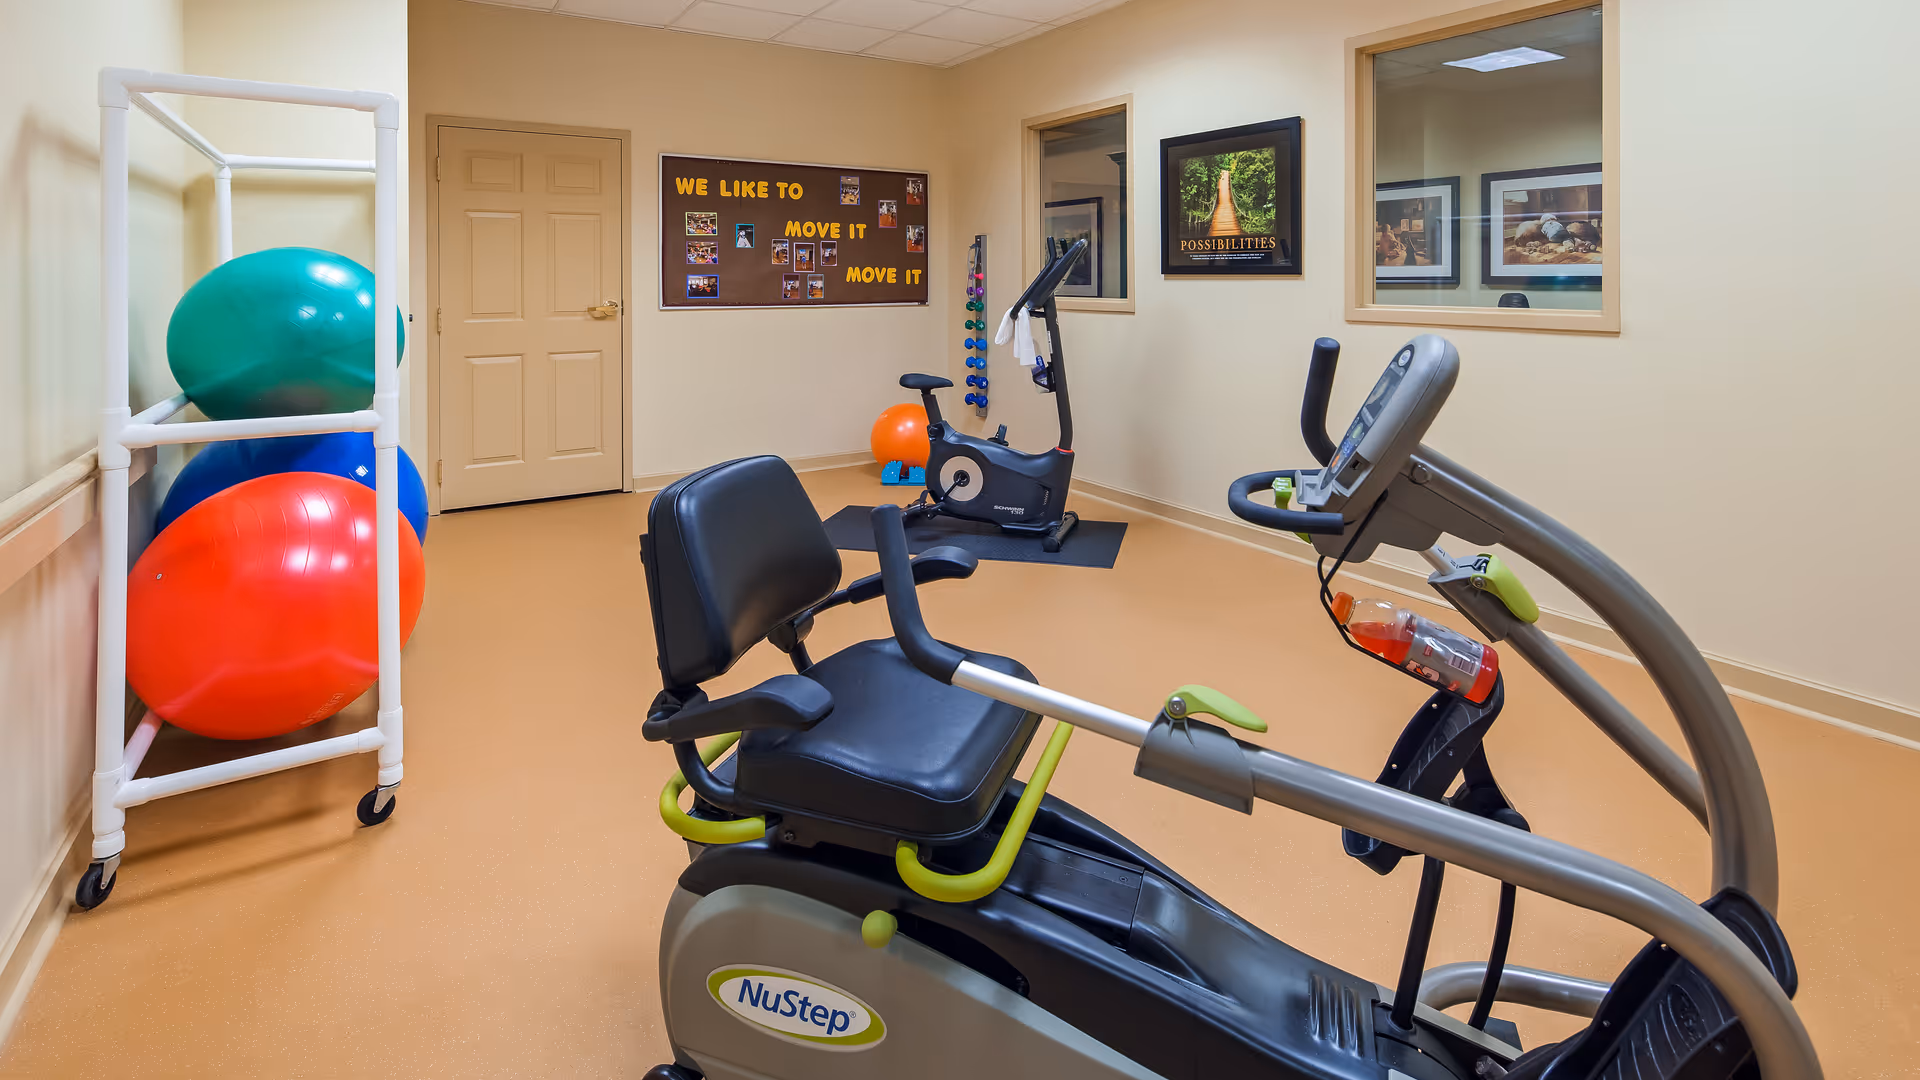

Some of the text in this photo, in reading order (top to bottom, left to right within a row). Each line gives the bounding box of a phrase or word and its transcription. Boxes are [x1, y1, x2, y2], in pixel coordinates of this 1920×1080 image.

[675, 177, 804, 200] WE LIKE TO
[785, 221, 867, 239] MOVE IT
[1180, 236, 1276, 251] POSSIBILITIES
[846, 266, 922, 285] MOVE IT
[737, 978, 851, 1035] NuStep
